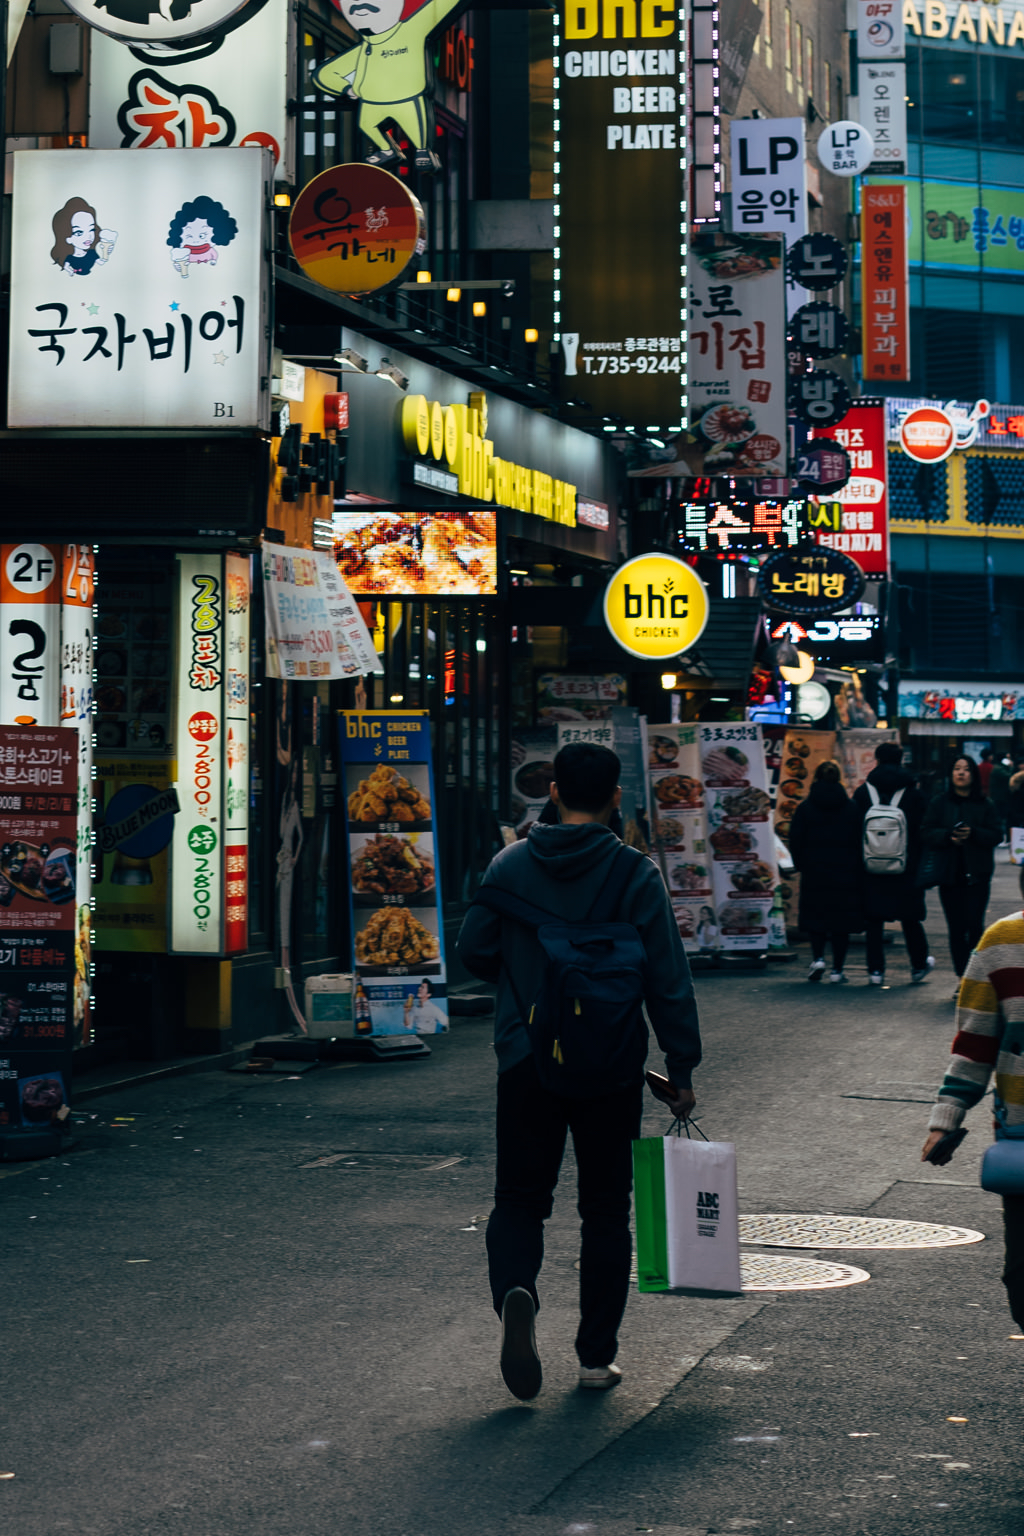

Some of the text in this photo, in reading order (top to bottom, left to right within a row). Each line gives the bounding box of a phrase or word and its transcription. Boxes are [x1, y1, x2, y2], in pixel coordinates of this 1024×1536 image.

[865, 4, 893, 17] 야구
[564, 48, 676, 78] CHICKEN
[612, 86, 676, 114] BEER
[606, 123, 676, 150] PLATE
[831, 129, 861, 148] LP
[738, 136, 799, 176] LP
[833, 161, 858, 170] BAR
[737, 188, 800, 224] 음악
[867, 193, 902, 207] S&U
[302, 187, 396, 264] 유가네
[873, 213, 894, 282] 에스앤유
[27, 295, 246, 374] 국자비어
[799, 243, 839, 419] 노래방
[872, 288, 899, 357] 피부과
[623, 337, 681, 352] 종로관철점
[582, 355, 681, 376] T.735-9244
[212, 401, 236, 418] B1
[834, 428, 864, 447] 치즈
[798, 457, 821, 478] 24
[819, 533, 882, 552] 부대찌개
[13, 552, 54, 582] 2F
[771, 572, 847, 598] 노래방
[624, 582, 689, 619] bhc
[189, 575, 221, 691] 28포차
[634, 626, 680, 638] CHICKEN
[8, 619, 47, 701] 룸
[346, 714, 382, 740] bhc
[191, 832, 215, 850] 소주
[696, 1190, 720, 1209] ABC
[696, 1208, 720, 1221] MART
